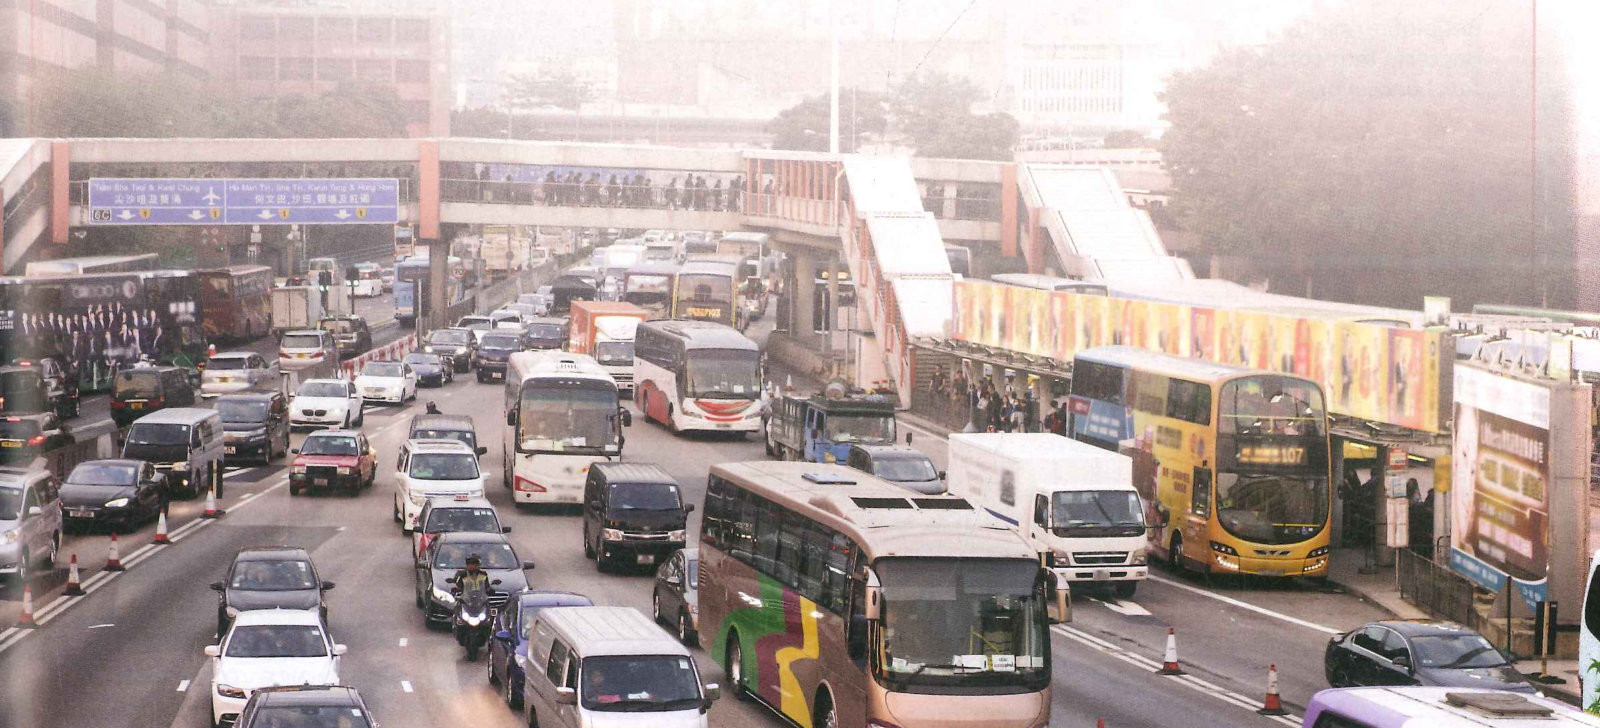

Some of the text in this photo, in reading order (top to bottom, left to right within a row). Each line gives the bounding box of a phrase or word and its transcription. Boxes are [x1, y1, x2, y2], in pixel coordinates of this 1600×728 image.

[178, 184, 200, 193] Chung
[94, 210, 111, 221] 6C
[1280, 447, 1304, 463] 107
